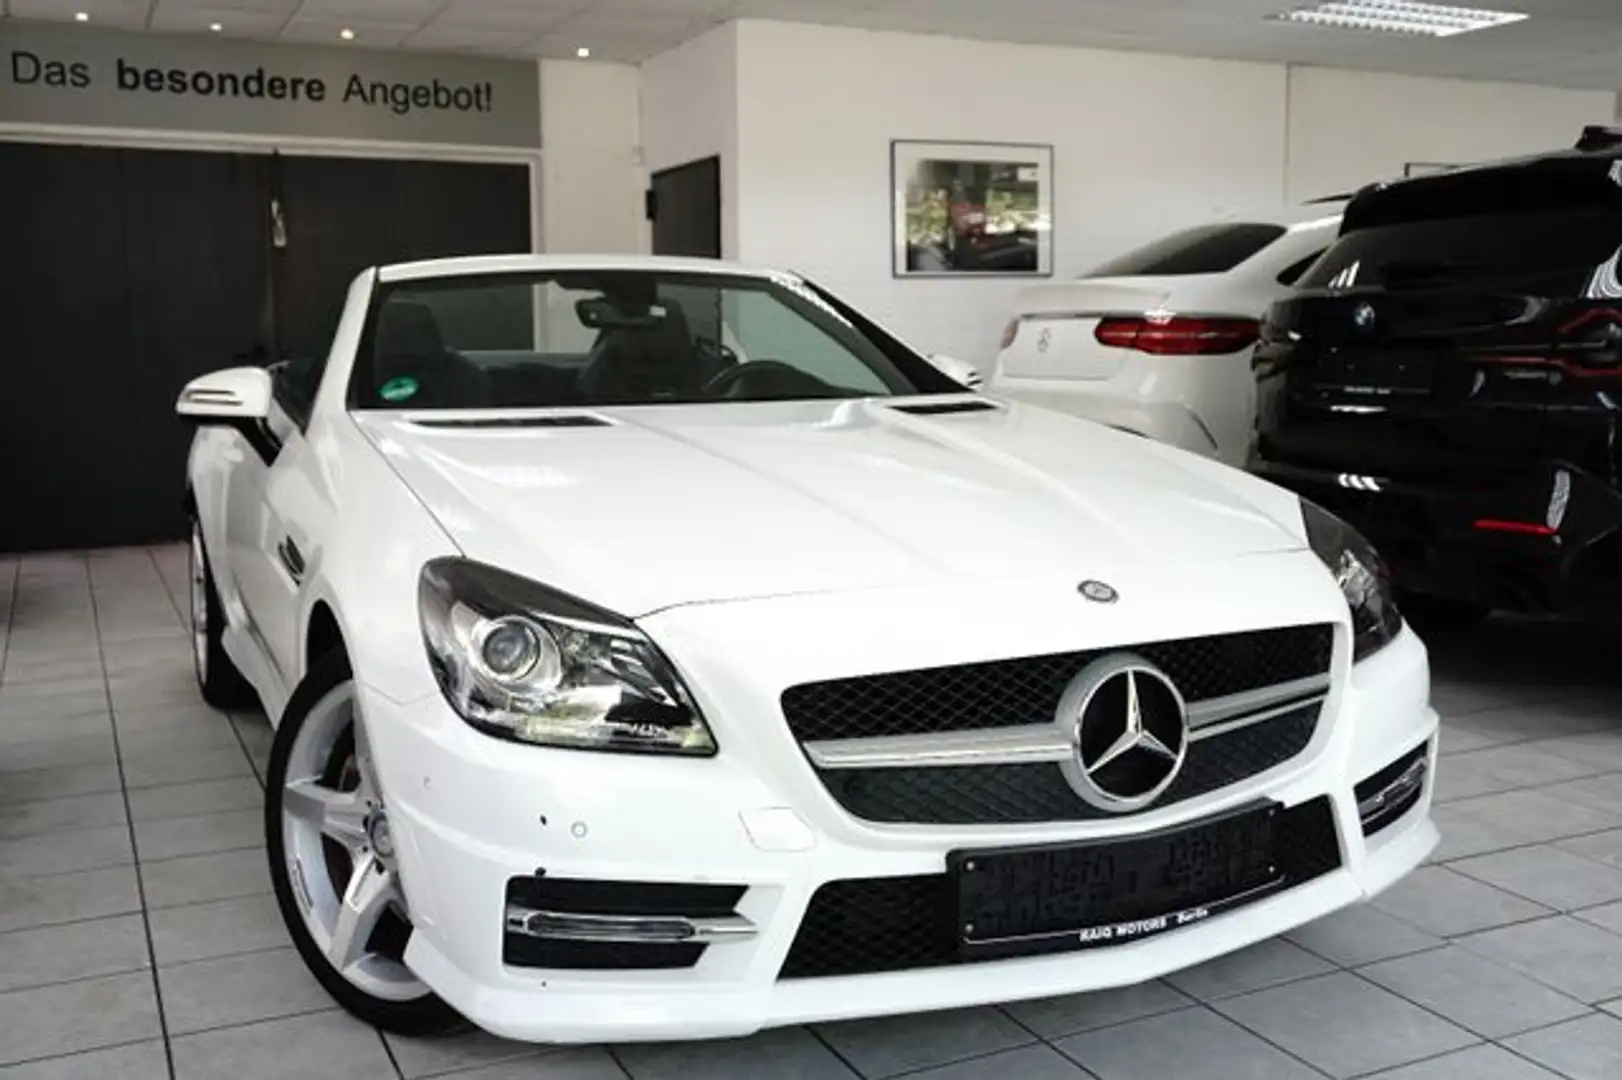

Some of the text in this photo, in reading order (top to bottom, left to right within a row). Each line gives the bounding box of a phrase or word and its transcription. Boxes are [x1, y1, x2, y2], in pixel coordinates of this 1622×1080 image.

[11, 51, 493, 115] Das besondere Angebot!
